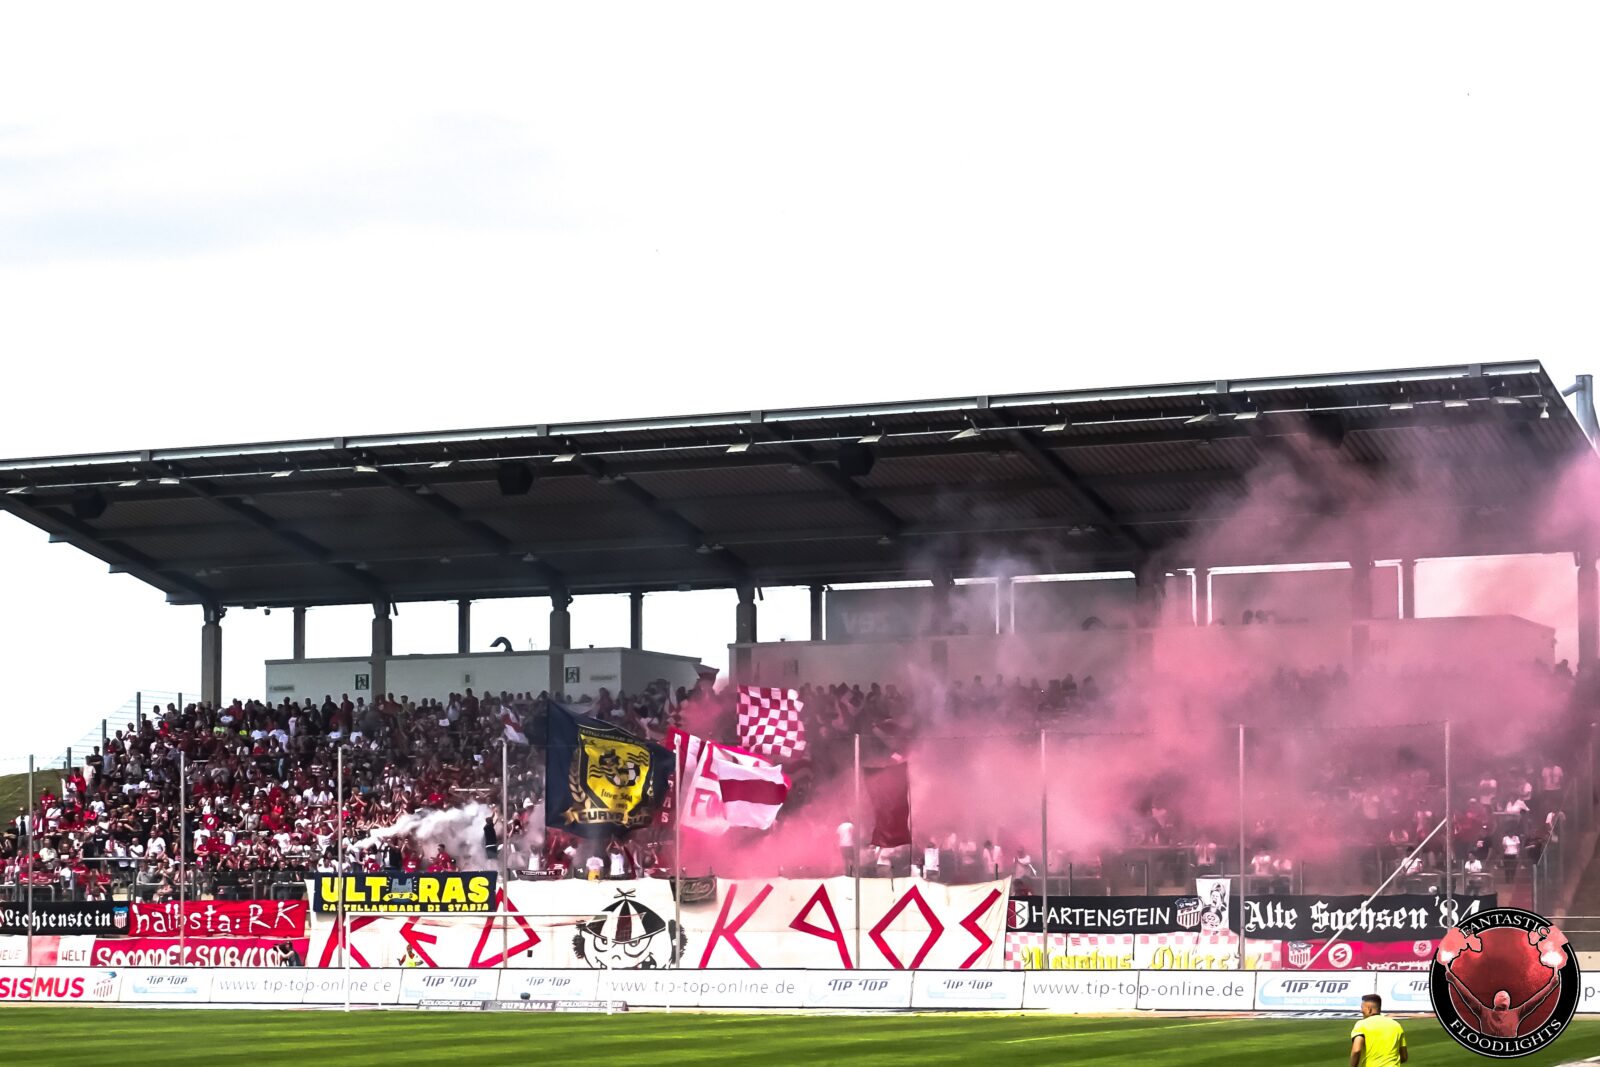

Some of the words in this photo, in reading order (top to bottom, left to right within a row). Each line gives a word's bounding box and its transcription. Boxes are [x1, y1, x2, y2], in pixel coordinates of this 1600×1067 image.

[322, 904, 421, 912] CATELLAMMARE
[427, 904, 441, 912] DI
[448, 903, 489, 912] STABIA
[4, 909, 112, 931] Lichtenstein
[1031, 905, 1170, 927] HARTENSTEIN
[1244, 901, 1298, 932] Alte
[1310, 900, 1429, 933] Sachsen
[698, 883, 1002, 968] KAOS
[61, 950, 87, 961] WELT
[0, 977, 86, 998] SISMUS
[422, 975, 445, 987] TIP
[450, 976, 478, 987] TOP
[828, 979, 854, 991] TIP
[858, 979, 890, 991] TOP
[943, 979, 964, 989] TIP
[968, 979, 993, 989] TOP
[1281, 980, 1311, 993] TIP
[1314, 980, 1351, 993] TOP
[1033, 980, 1245, 998] www.tip-top-online.de
[501, 1001, 553, 1010] SUPRAMAX
